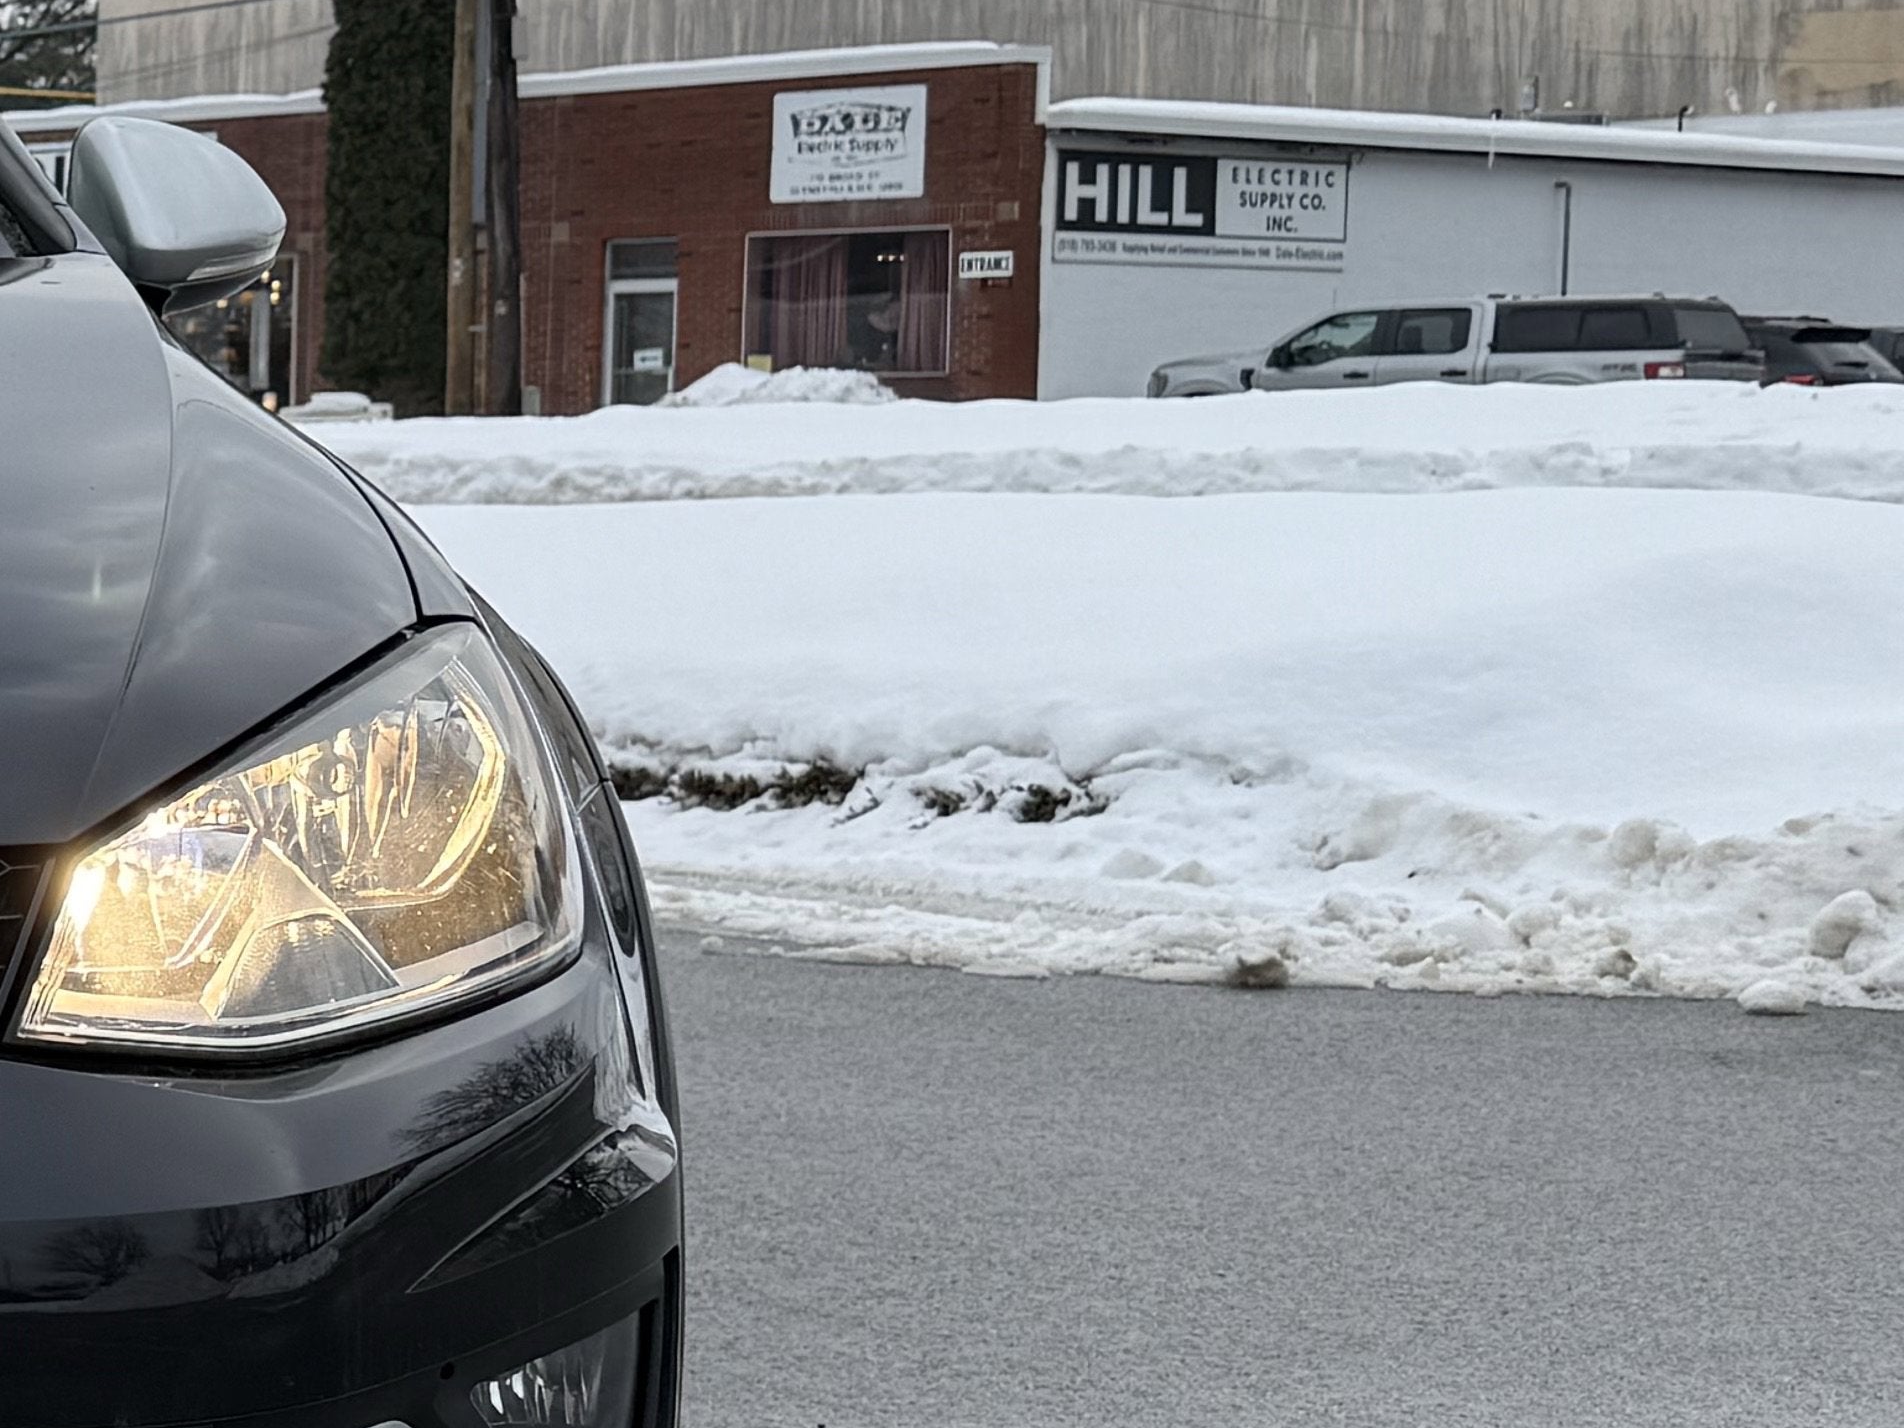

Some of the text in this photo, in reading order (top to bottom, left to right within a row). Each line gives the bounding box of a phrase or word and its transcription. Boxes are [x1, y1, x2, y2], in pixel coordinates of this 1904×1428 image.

[1231, 166, 1337, 189] ELECTRIC
[1063, 160, 1204, 228] HILL
[1239, 191, 1326, 211] SUPPLY CO.
[1266, 216, 1299, 234] INC.
